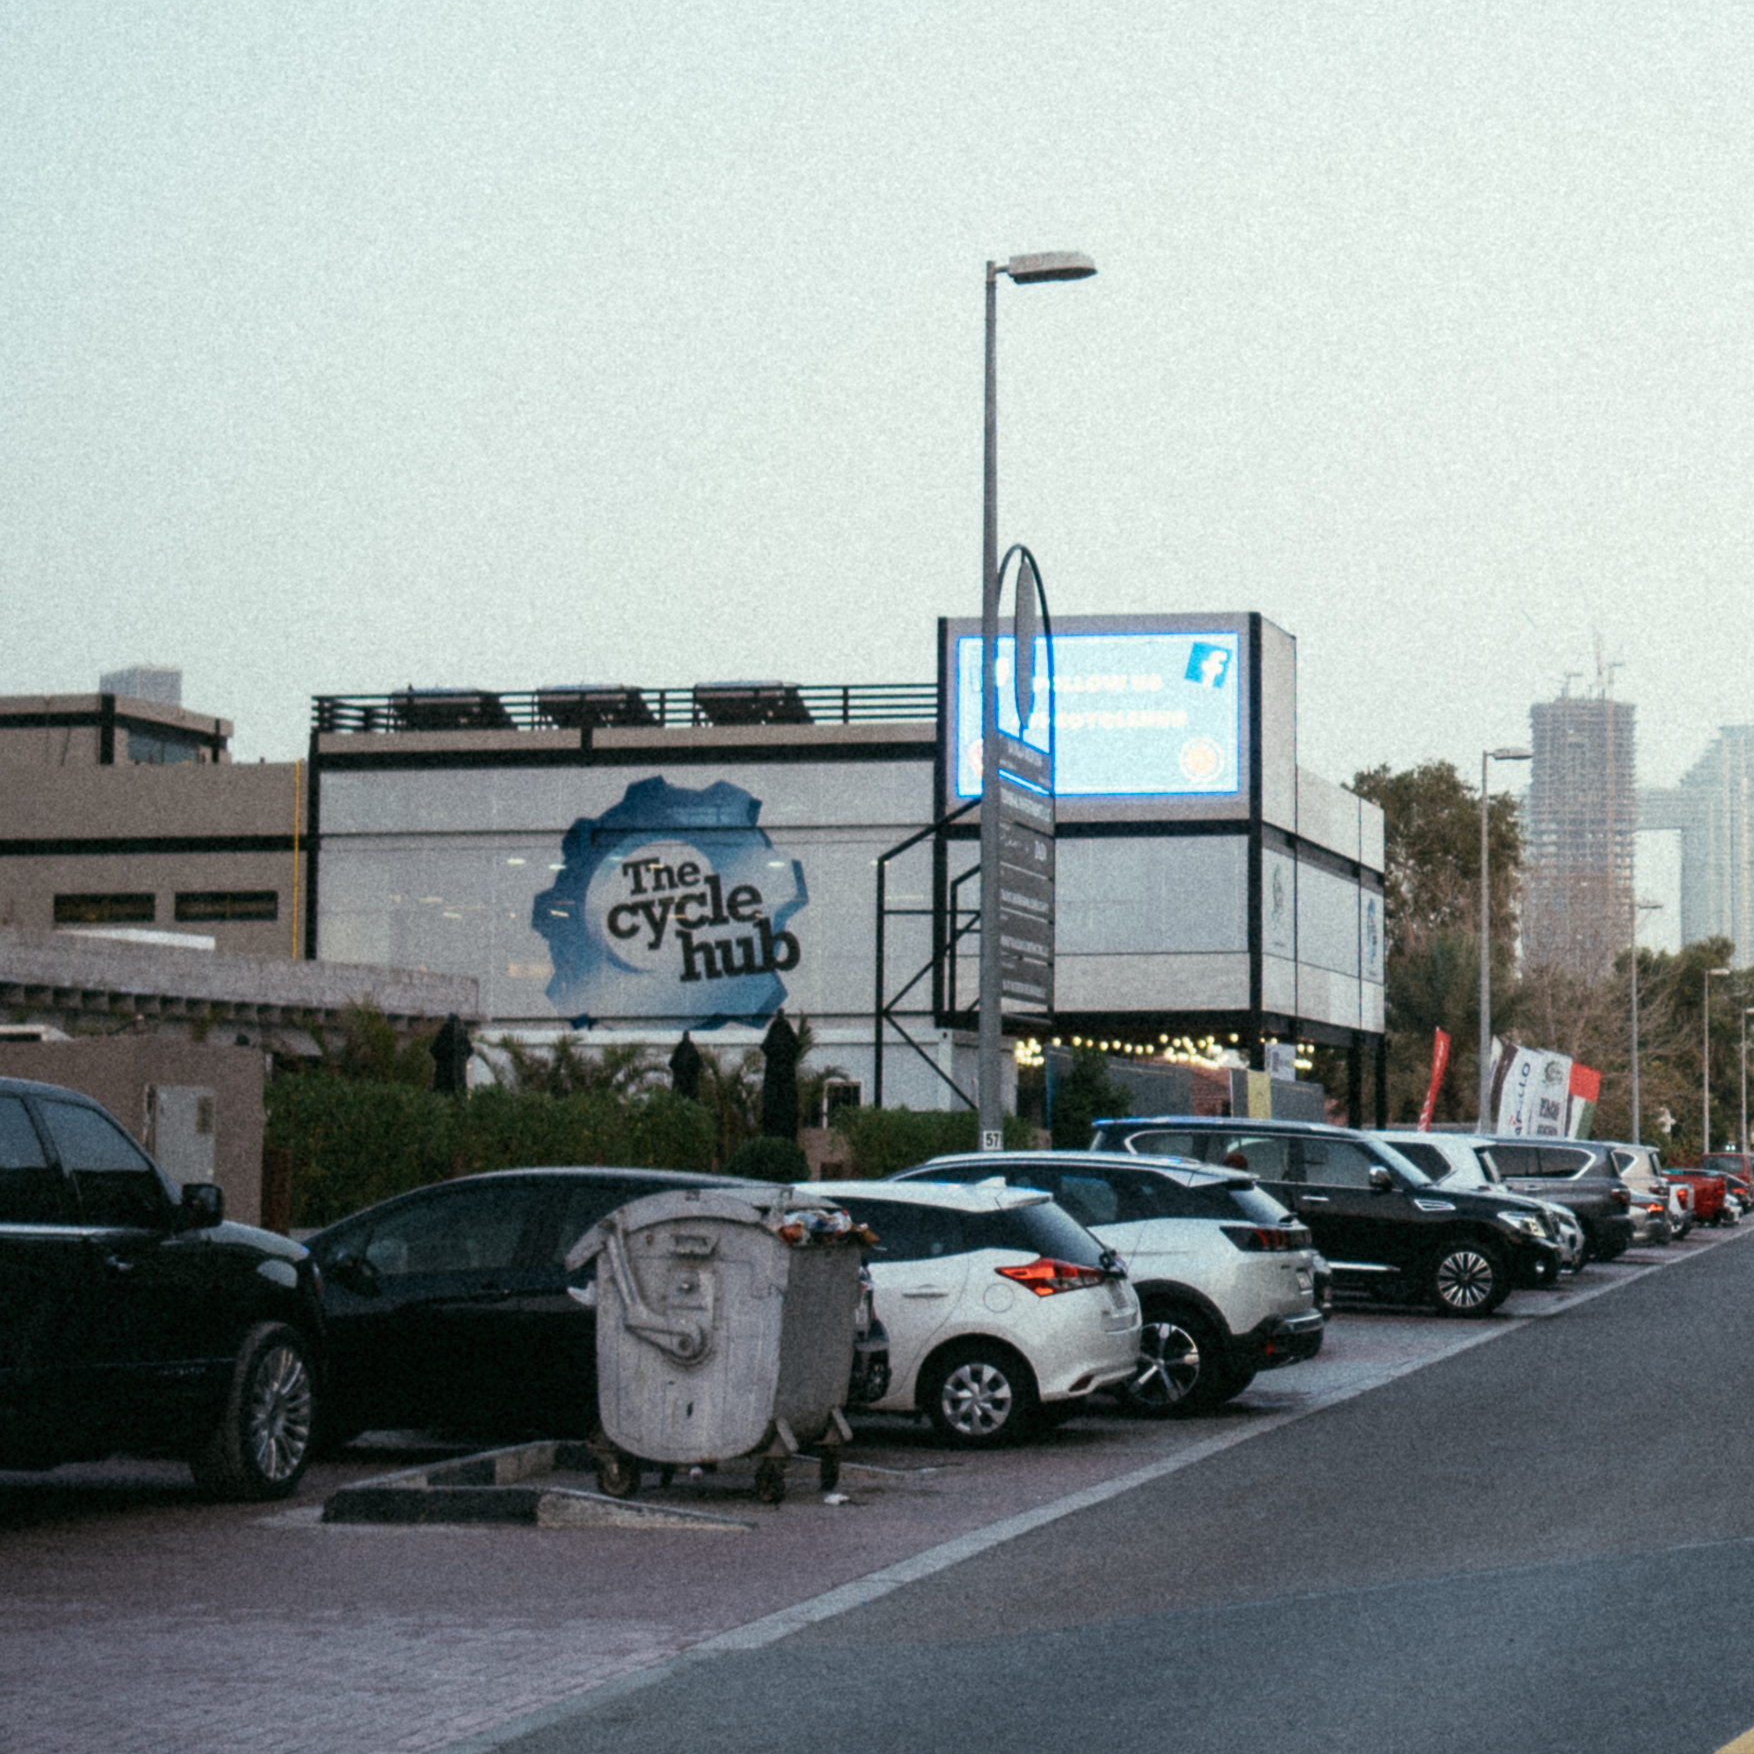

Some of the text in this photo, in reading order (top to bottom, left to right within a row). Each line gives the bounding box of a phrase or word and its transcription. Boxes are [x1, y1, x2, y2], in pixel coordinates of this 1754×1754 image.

[606, 873, 763, 950] cycle
[675, 915, 801, 982] hub
[986, 1132, 999, 1147] 57
